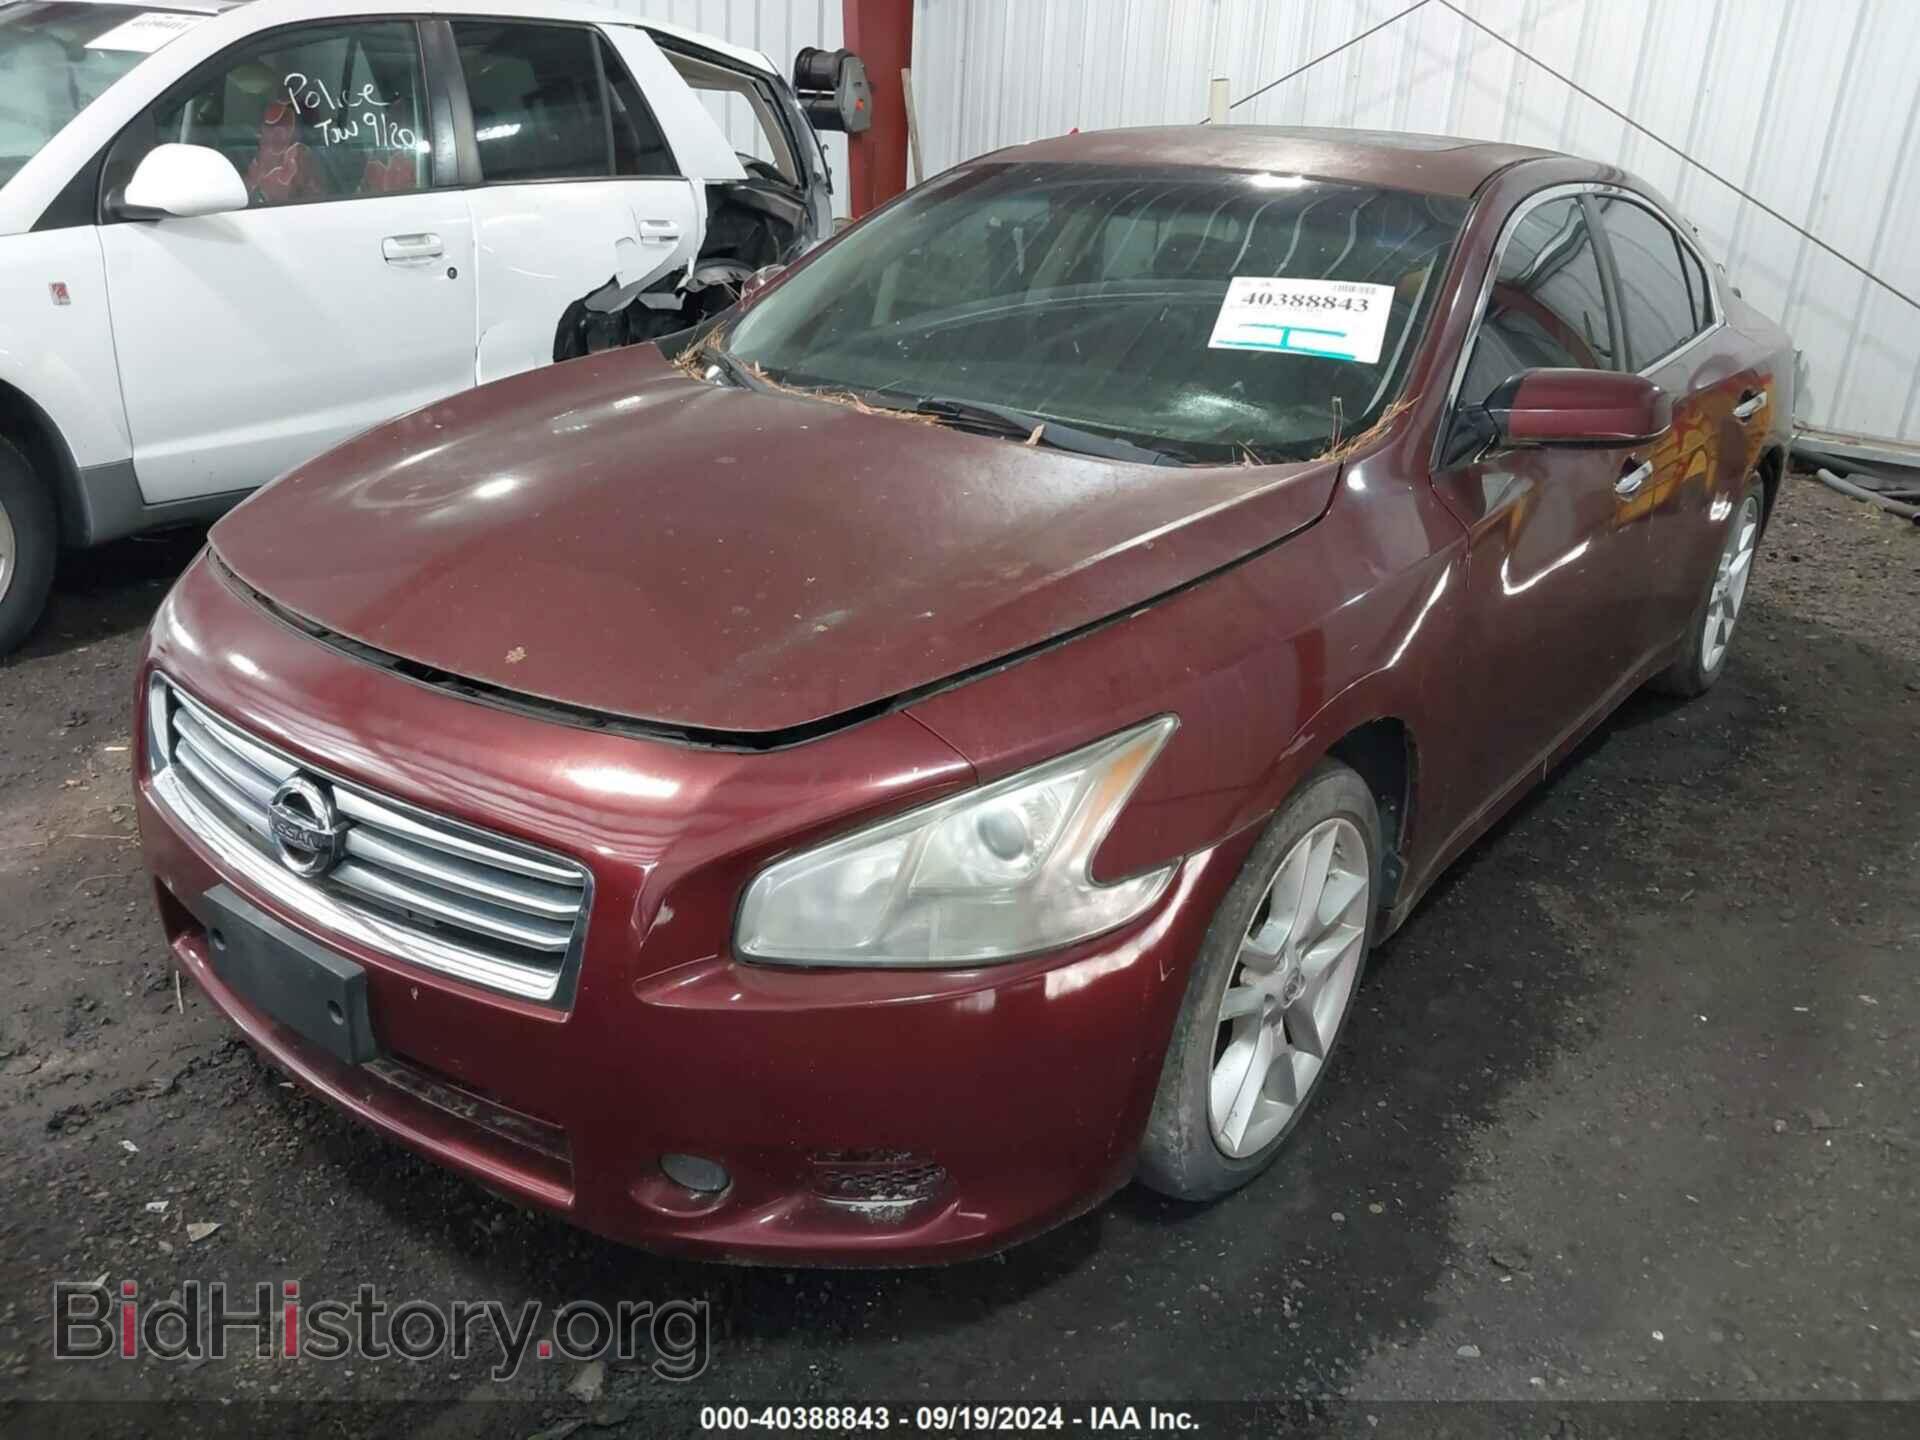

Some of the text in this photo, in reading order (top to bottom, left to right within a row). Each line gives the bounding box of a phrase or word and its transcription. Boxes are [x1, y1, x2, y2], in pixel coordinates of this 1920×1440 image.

[284, 73, 391, 114] Police
[1241, 292, 1369, 312] 40388843
[272, 822, 321, 850] SSAN
